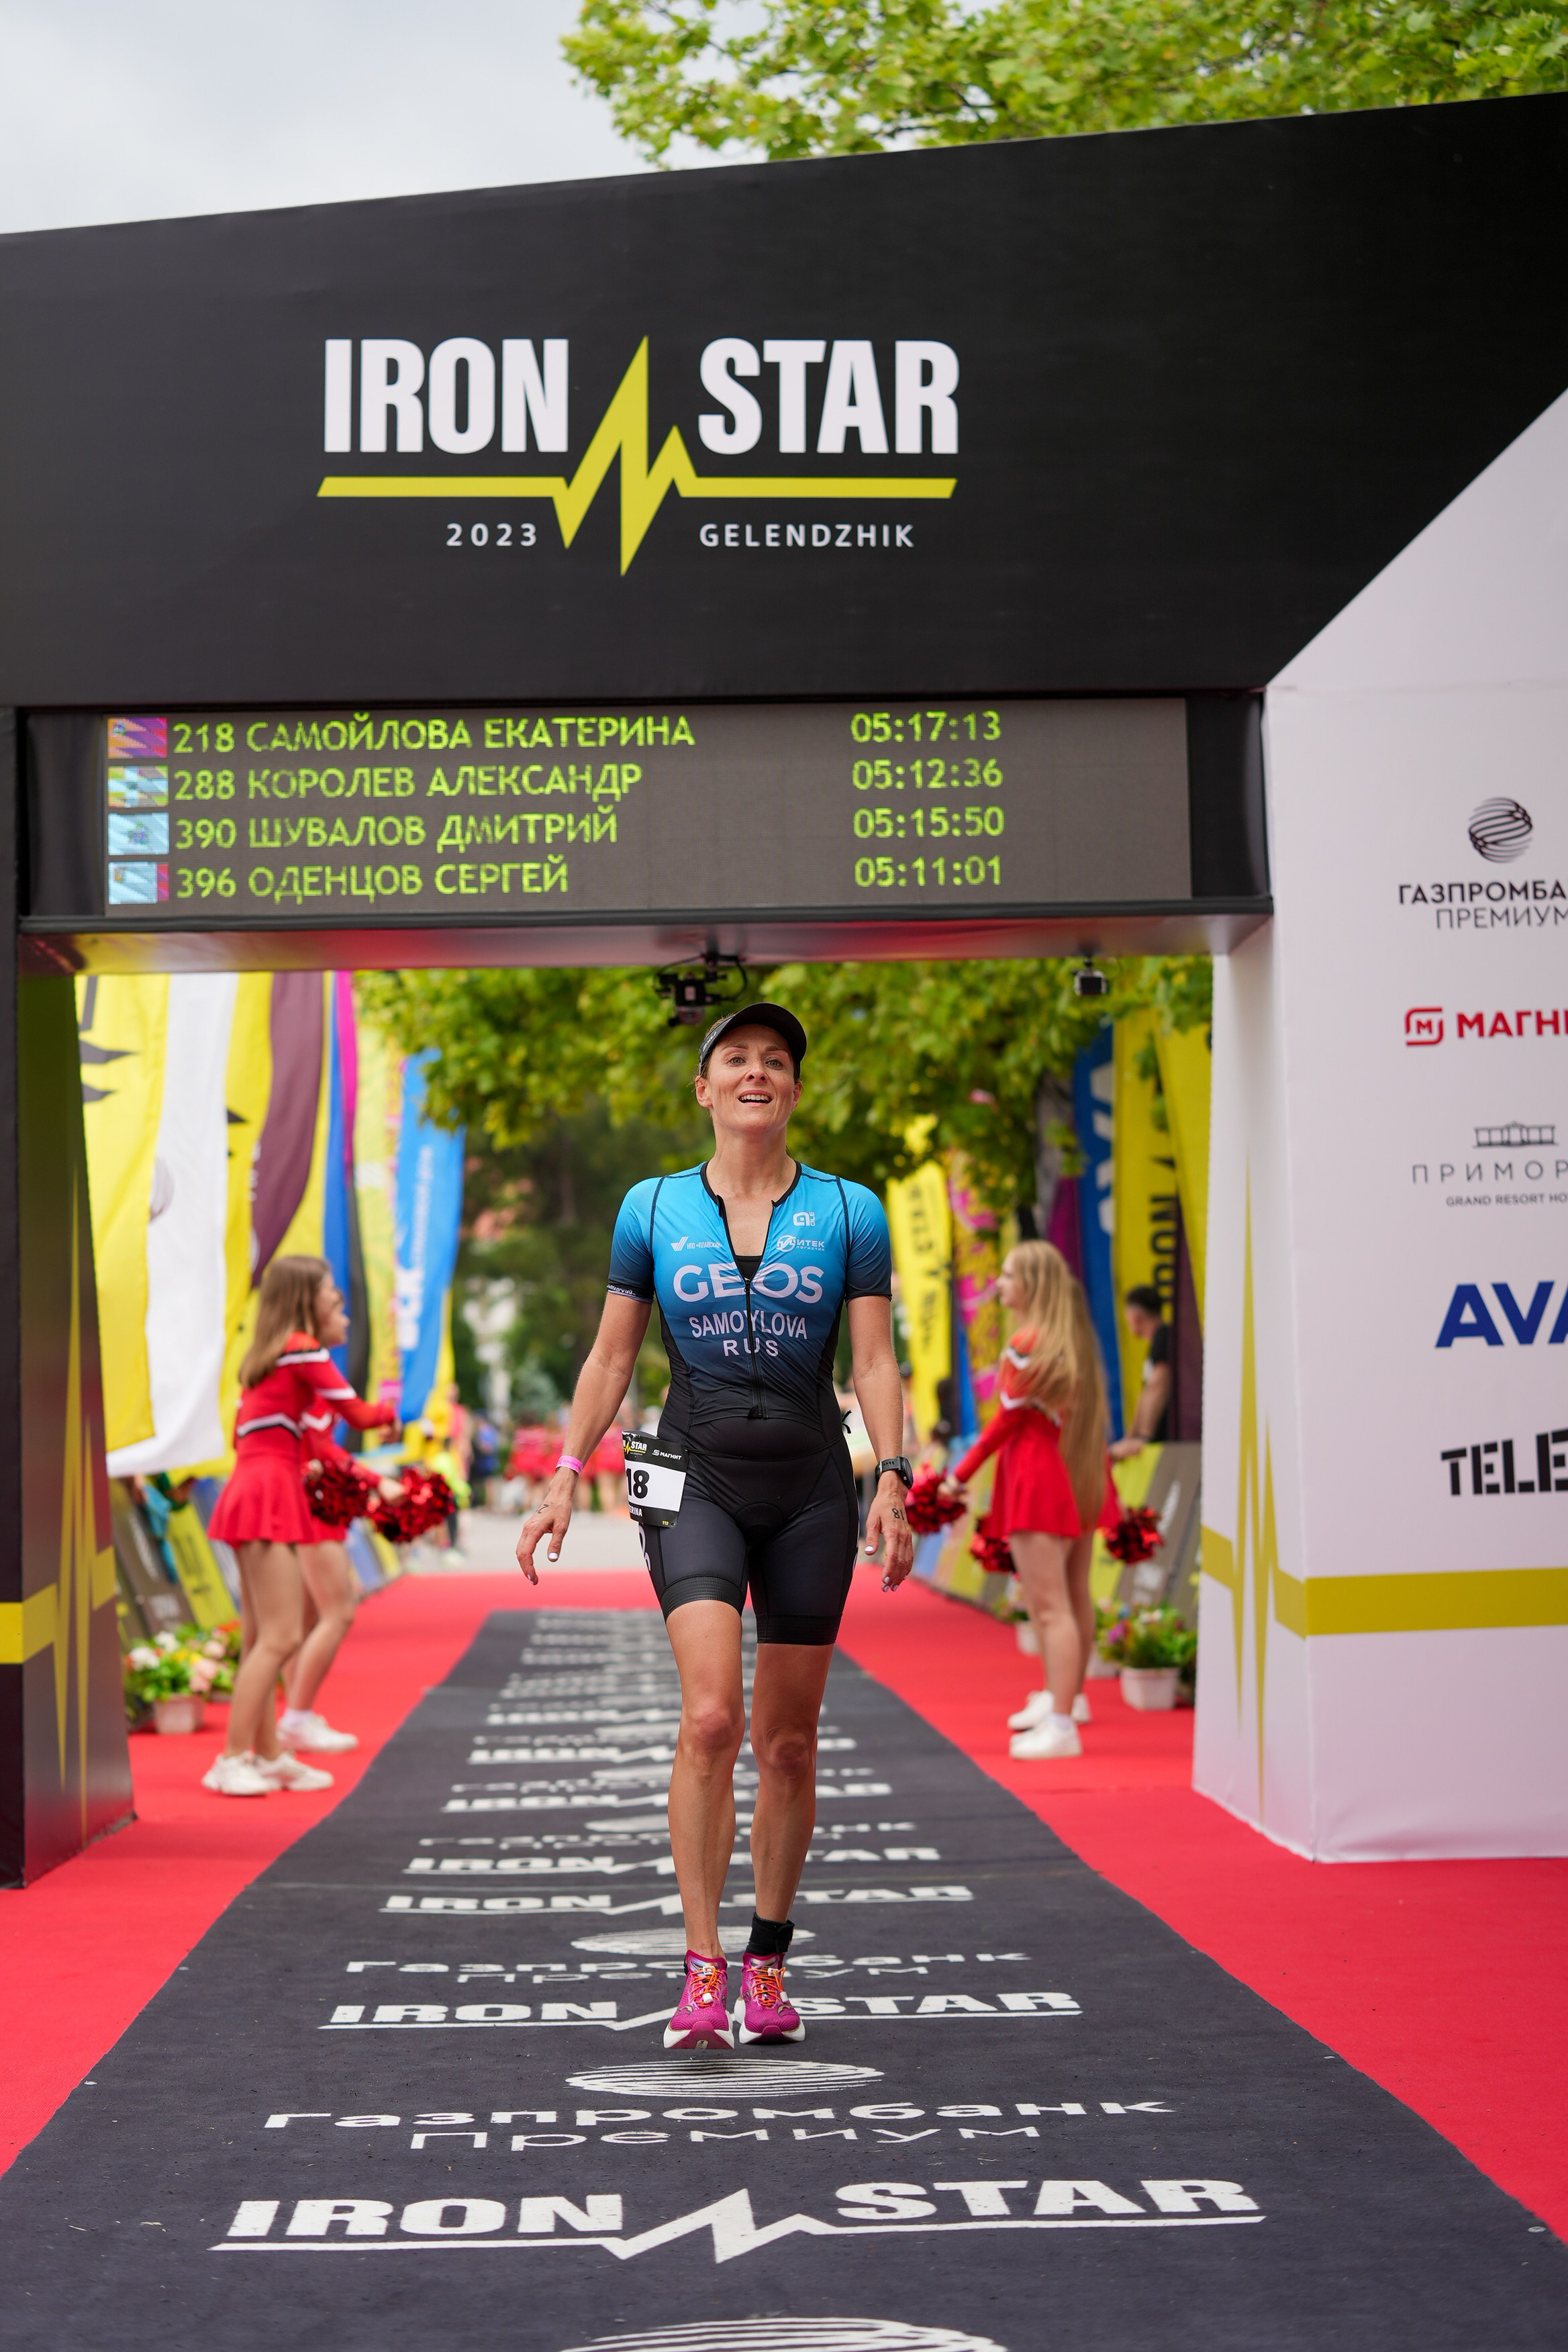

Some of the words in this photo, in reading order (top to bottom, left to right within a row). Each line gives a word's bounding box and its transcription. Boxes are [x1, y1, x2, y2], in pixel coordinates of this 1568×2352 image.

[325, 337, 569, 454] IRON
[699, 338, 959, 455] STAR
[446, 523, 537, 547] 2023
[699, 523, 914, 548] GELENDZHIK
[173, 722, 235, 752] 218
[246, 712, 473, 752] САМОЙЛОВА
[484, 716, 695, 749] ЕКАТЕРИНА
[850, 710, 1002, 743] 05:17:13
[174, 769, 236, 800] 288
[248, 767, 416, 799] КОРОЛЕВ
[426, 763, 642, 802] АЛЕКСАНДР
[852, 758, 1003, 791] 05:12:36
[175, 816, 237, 849] 390
[248, 815, 427, 848] ШУВАЛОВ
[436, 804, 618, 854] ДМИТРИЙ
[853, 805, 1005, 838] 05:15:50
[176, 867, 238, 899] 396
[248, 863, 424, 905] ОДЕНЦОВ
[434, 854, 569, 895] СЕРГЕЙ
[854, 855, 1001, 887] 05:11:01
[1398, 879, 1568, 905] ГАЗПРОМБА
[1457, 1009, 1568, 1038] МАГН
[1445, 1195, 1492, 1206] GRAND
[1495, 1192, 1545, 1206] RESORT
[797, 1238, 825, 1248] ИТЕК
[673, 1263, 824, 1304] GEOS
[689, 1310, 807, 1340] SAMOYLOVA
[631, 1440, 648, 1451] STAR
[660, 1451, 682, 1461] МАГНИТ
[385, 1894, 612, 1910] IRON
[330, 2001, 618, 2023] IRON
[787, 1992, 1081, 2014] STAR
[264, 2102, 1176, 2126] Газпромбанк
[410, 2126, 1041, 2151] Премиум
[226, 2194, 623, 2237] IRON
[835, 2179, 1261, 2220] STAR
